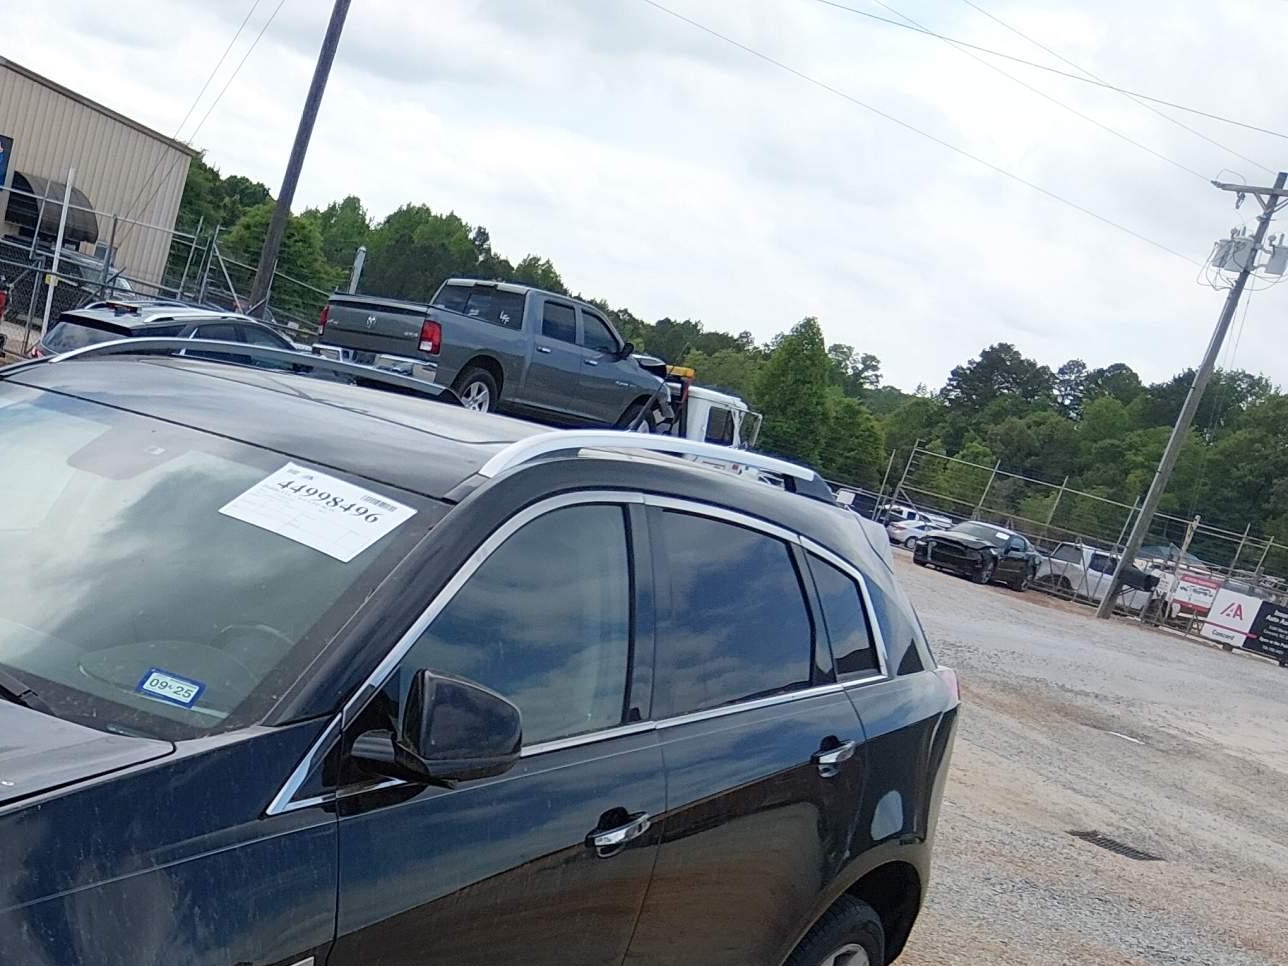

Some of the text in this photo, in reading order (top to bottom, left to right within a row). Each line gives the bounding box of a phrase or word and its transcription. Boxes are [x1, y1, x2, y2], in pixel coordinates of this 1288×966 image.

[278, 480, 384, 523] 44998496
[149, 678, 193, 698] 09 25
